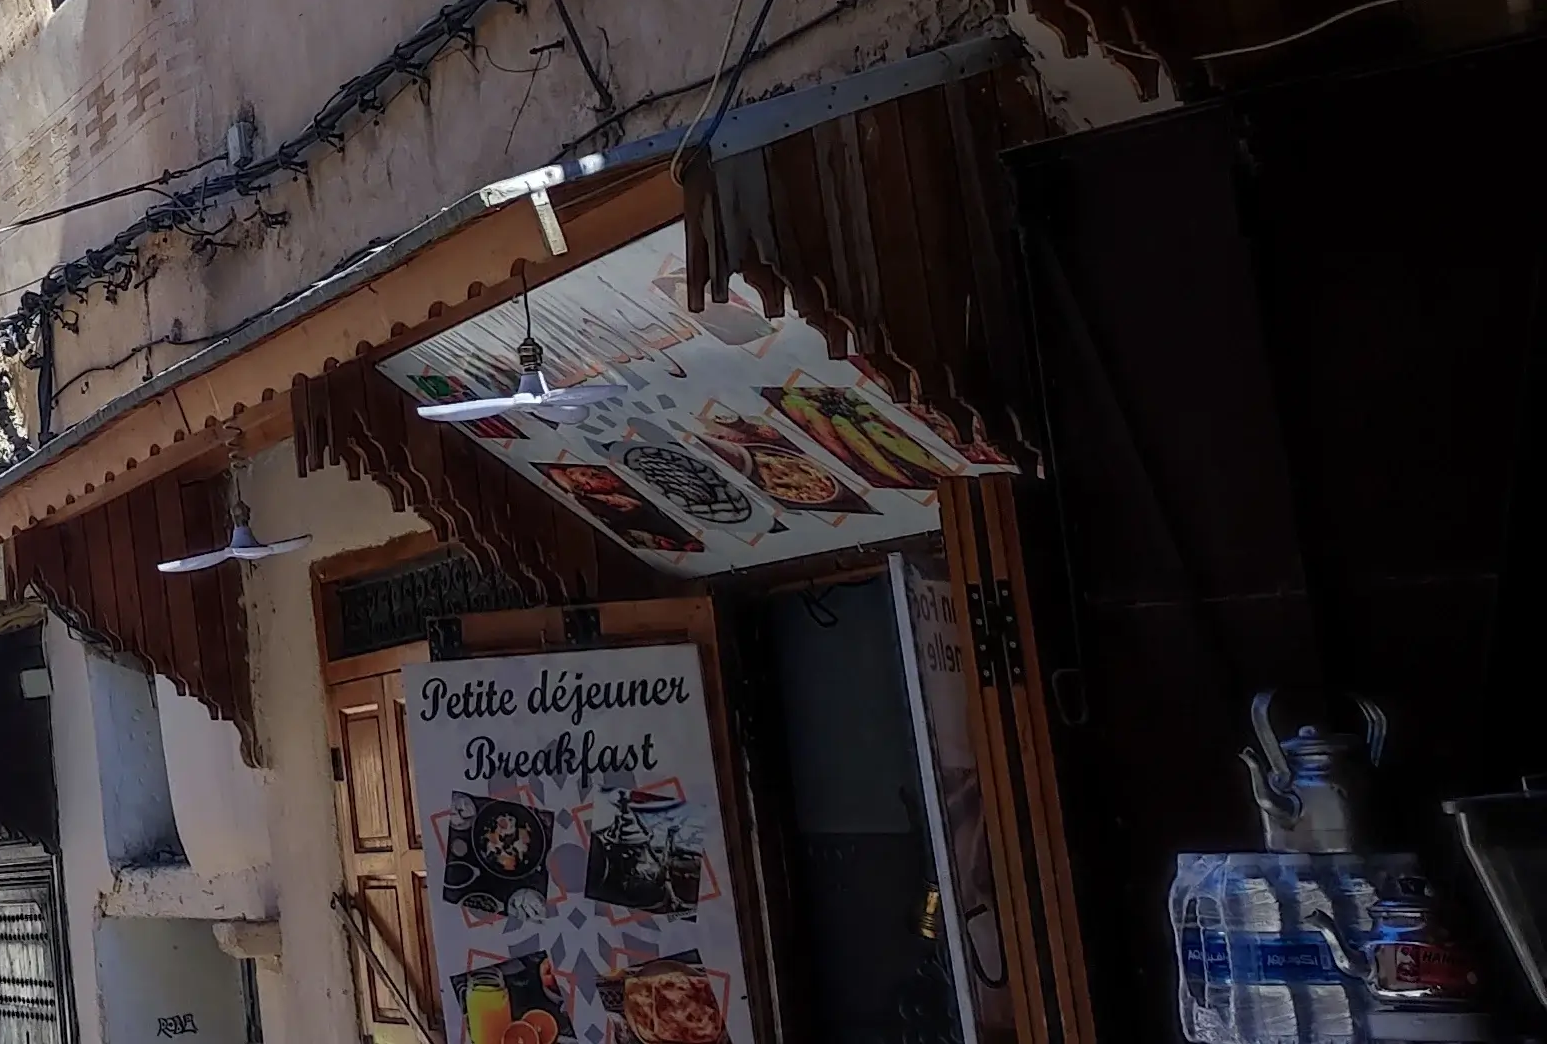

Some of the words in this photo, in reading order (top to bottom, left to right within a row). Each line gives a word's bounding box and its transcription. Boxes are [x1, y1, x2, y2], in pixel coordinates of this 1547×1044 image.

[420, 677, 517, 721] Petite
[527, 669, 689, 725] déjeuner
[464, 729, 657, 789] Breakfast
